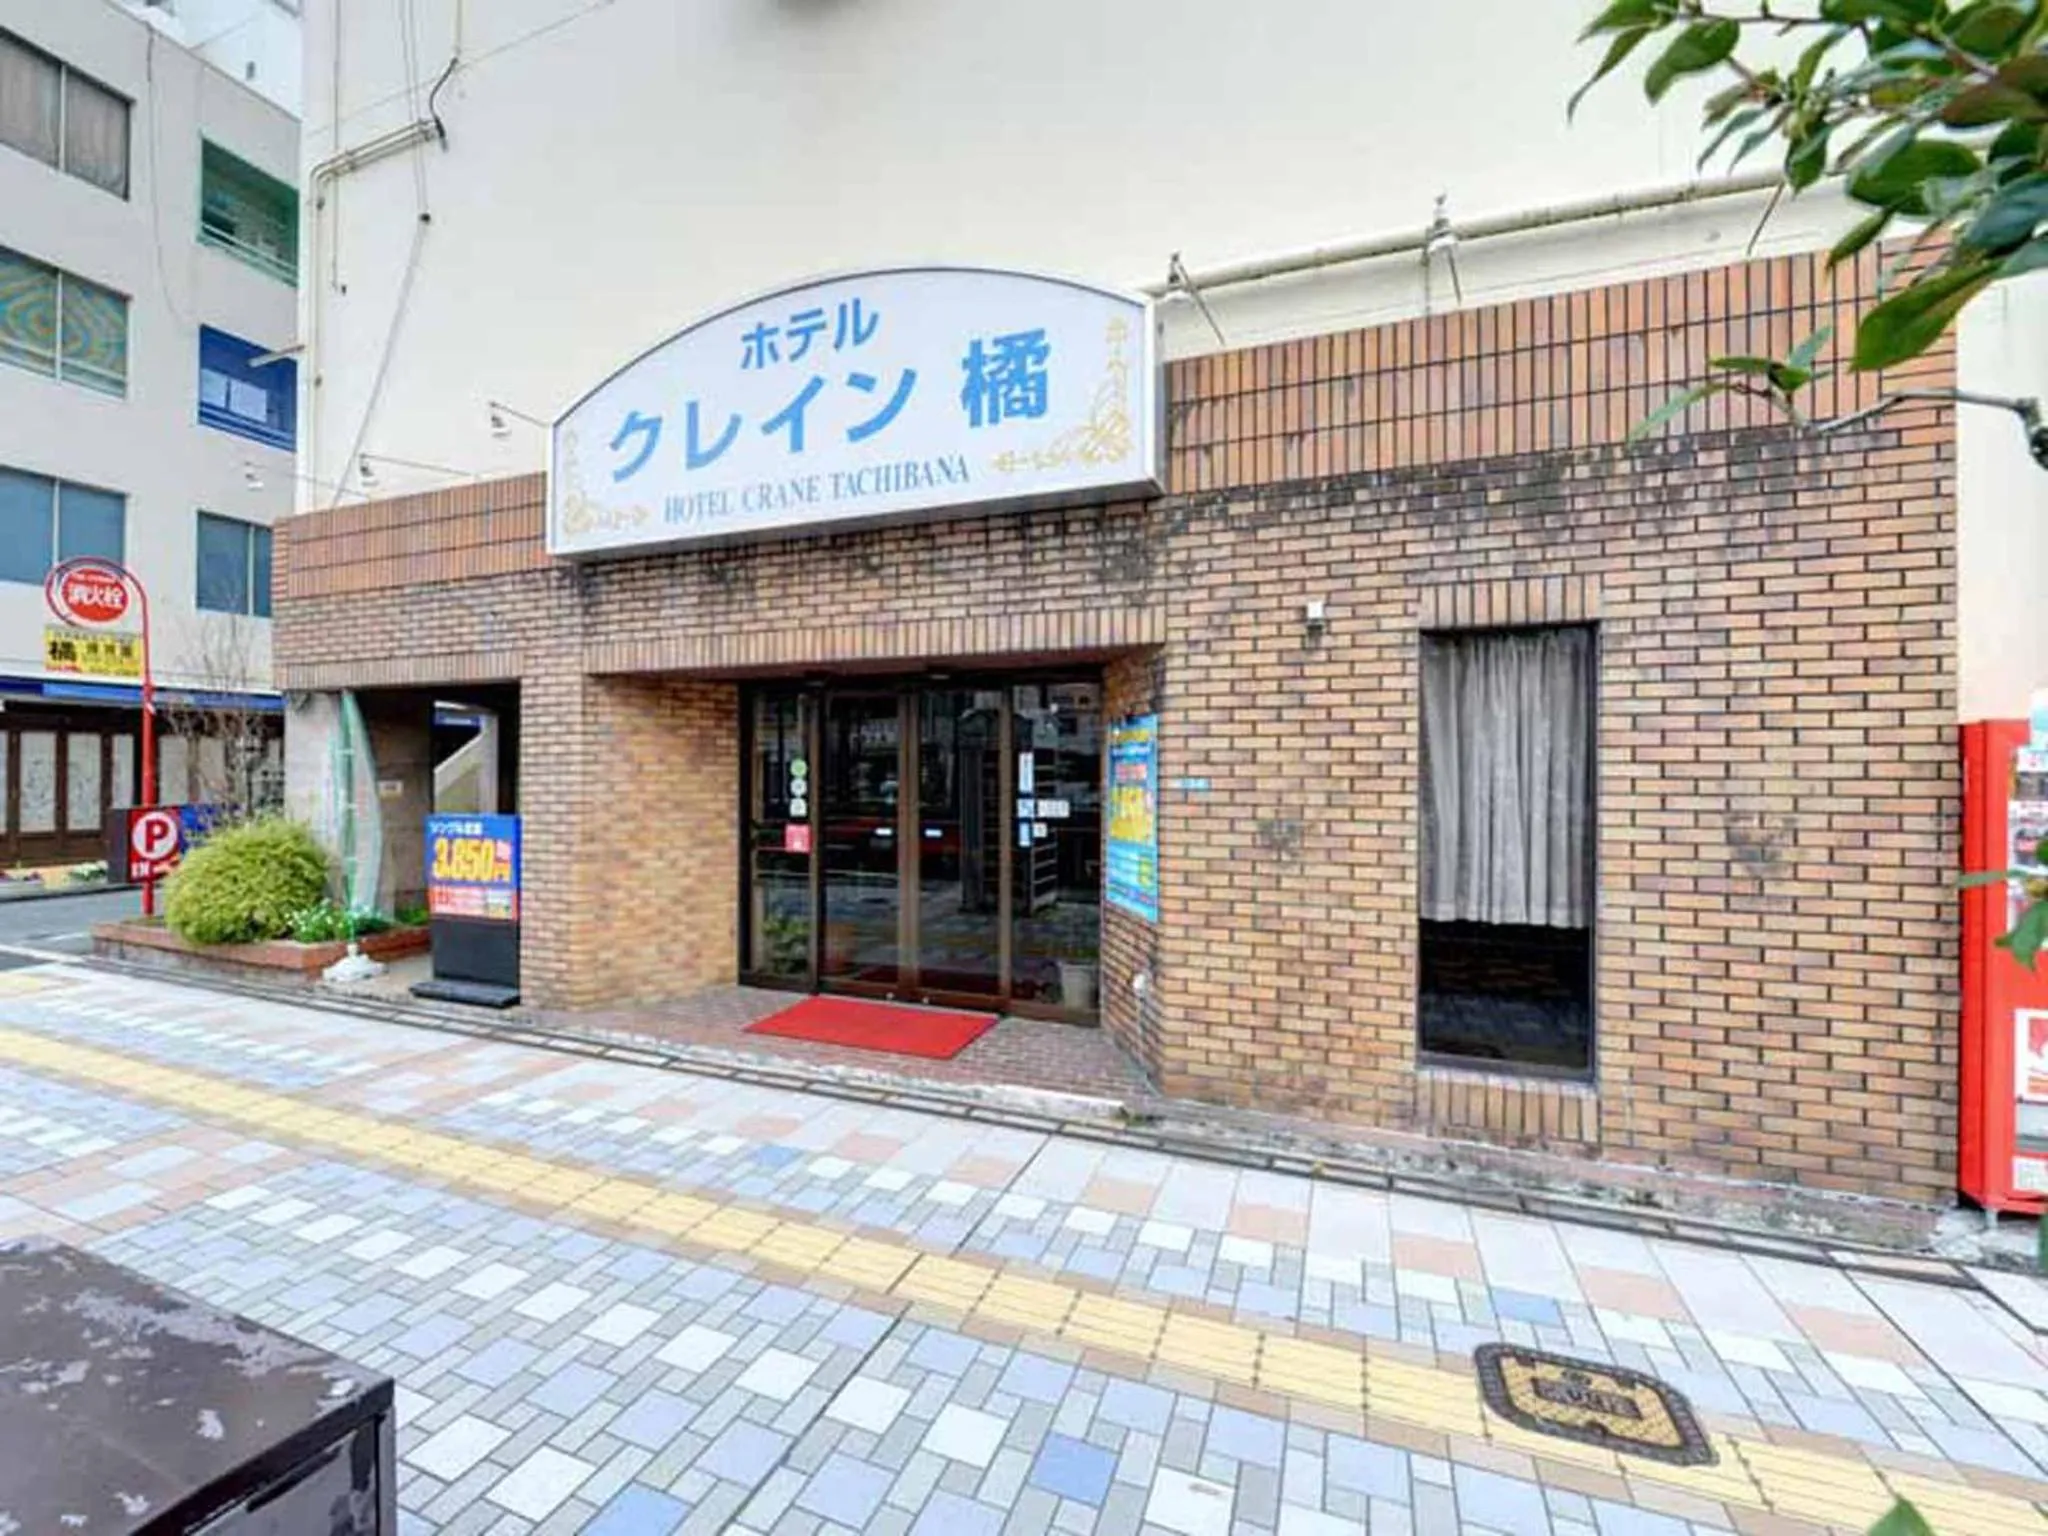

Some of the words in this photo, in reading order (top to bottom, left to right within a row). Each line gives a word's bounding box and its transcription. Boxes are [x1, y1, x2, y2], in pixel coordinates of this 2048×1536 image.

[740, 297, 880, 370] ホテル
[609, 367, 918, 481] クレイン
[960, 328, 1052, 429] 橘
[663, 489, 733, 525] HOTEL
[740, 474, 822, 514] CRANE
[828, 451, 971, 501] TACHIBANA
[67, 581, 124, 610] 消火栓
[144, 819, 170, 854] P
